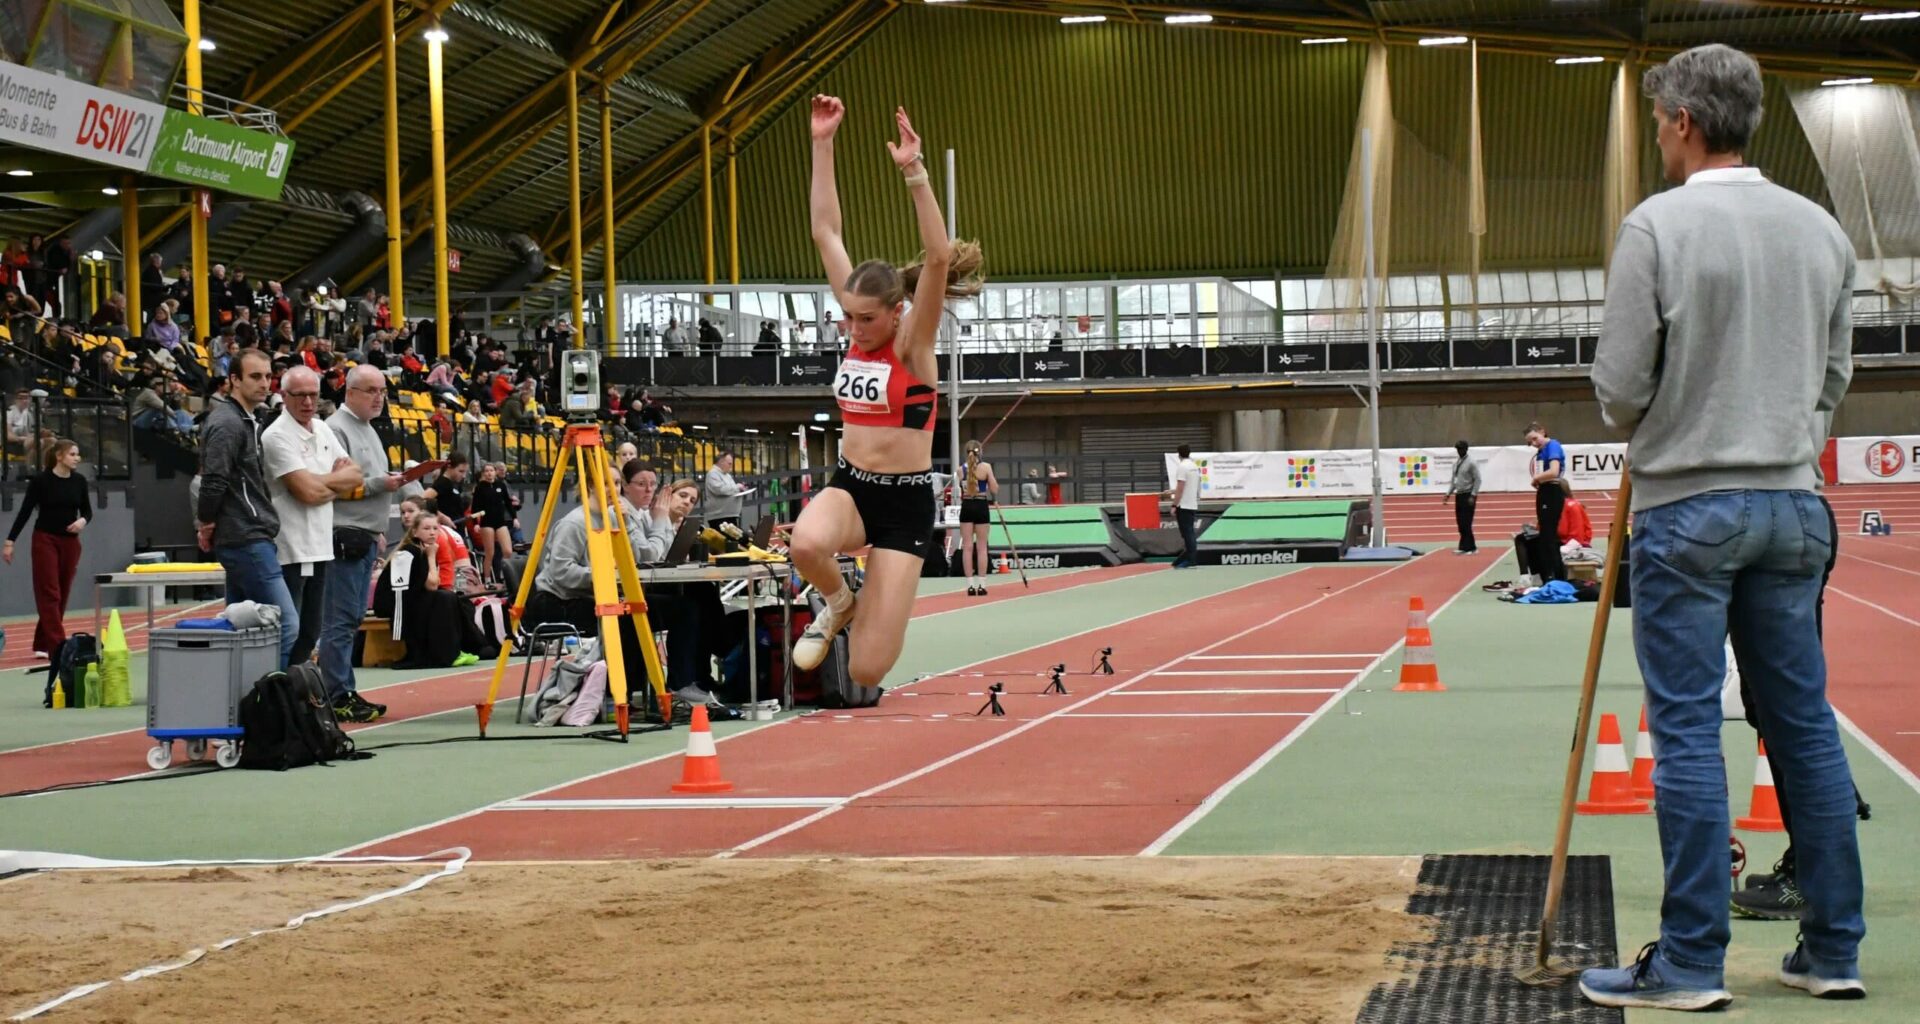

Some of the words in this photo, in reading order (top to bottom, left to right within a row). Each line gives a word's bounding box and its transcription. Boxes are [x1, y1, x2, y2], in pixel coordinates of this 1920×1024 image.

[20, 114, 29, 132] &
[31, 116, 57, 139] Bahn
[76, 98, 154, 159] DSW21
[181, 128, 235, 161] Dortmund
[231, 141, 267, 172] Airport
[202, 192, 210, 213] K
[838, 373, 879, 401] 266
[850, 466, 895, 486] NIKE
[897, 472, 933, 486] PRO
[1865, 513, 1878, 531] 5
[1221, 549, 1298, 565] vennekel
